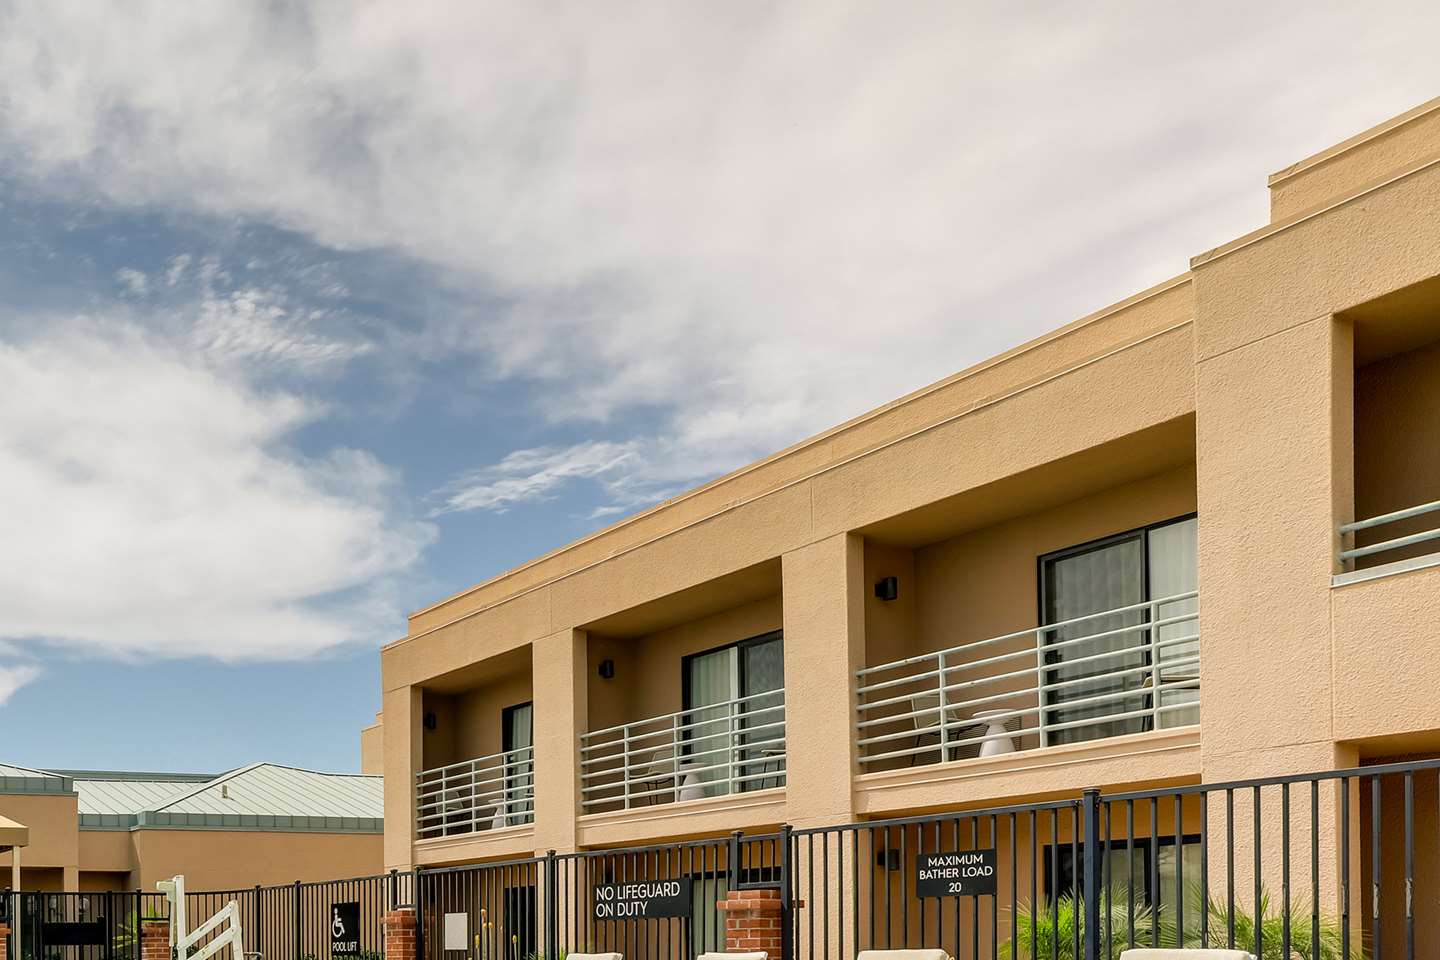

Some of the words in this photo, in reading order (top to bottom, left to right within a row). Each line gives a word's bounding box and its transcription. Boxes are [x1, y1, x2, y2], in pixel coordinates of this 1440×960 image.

[928, 854, 983, 867] MAXIMUM
[919, 868, 959, 880] BATHER
[962, 866, 993, 877] LOAD
[596, 886, 614, 900] NO
[617, 881, 680, 899] LIFEGUARD
[948, 882, 962, 893] 20
[596, 903, 614, 917] ON
[617, 901, 648, 916] DUTY
[332, 941, 347, 952] POOL
[347, 941, 358, 951] LIFT
